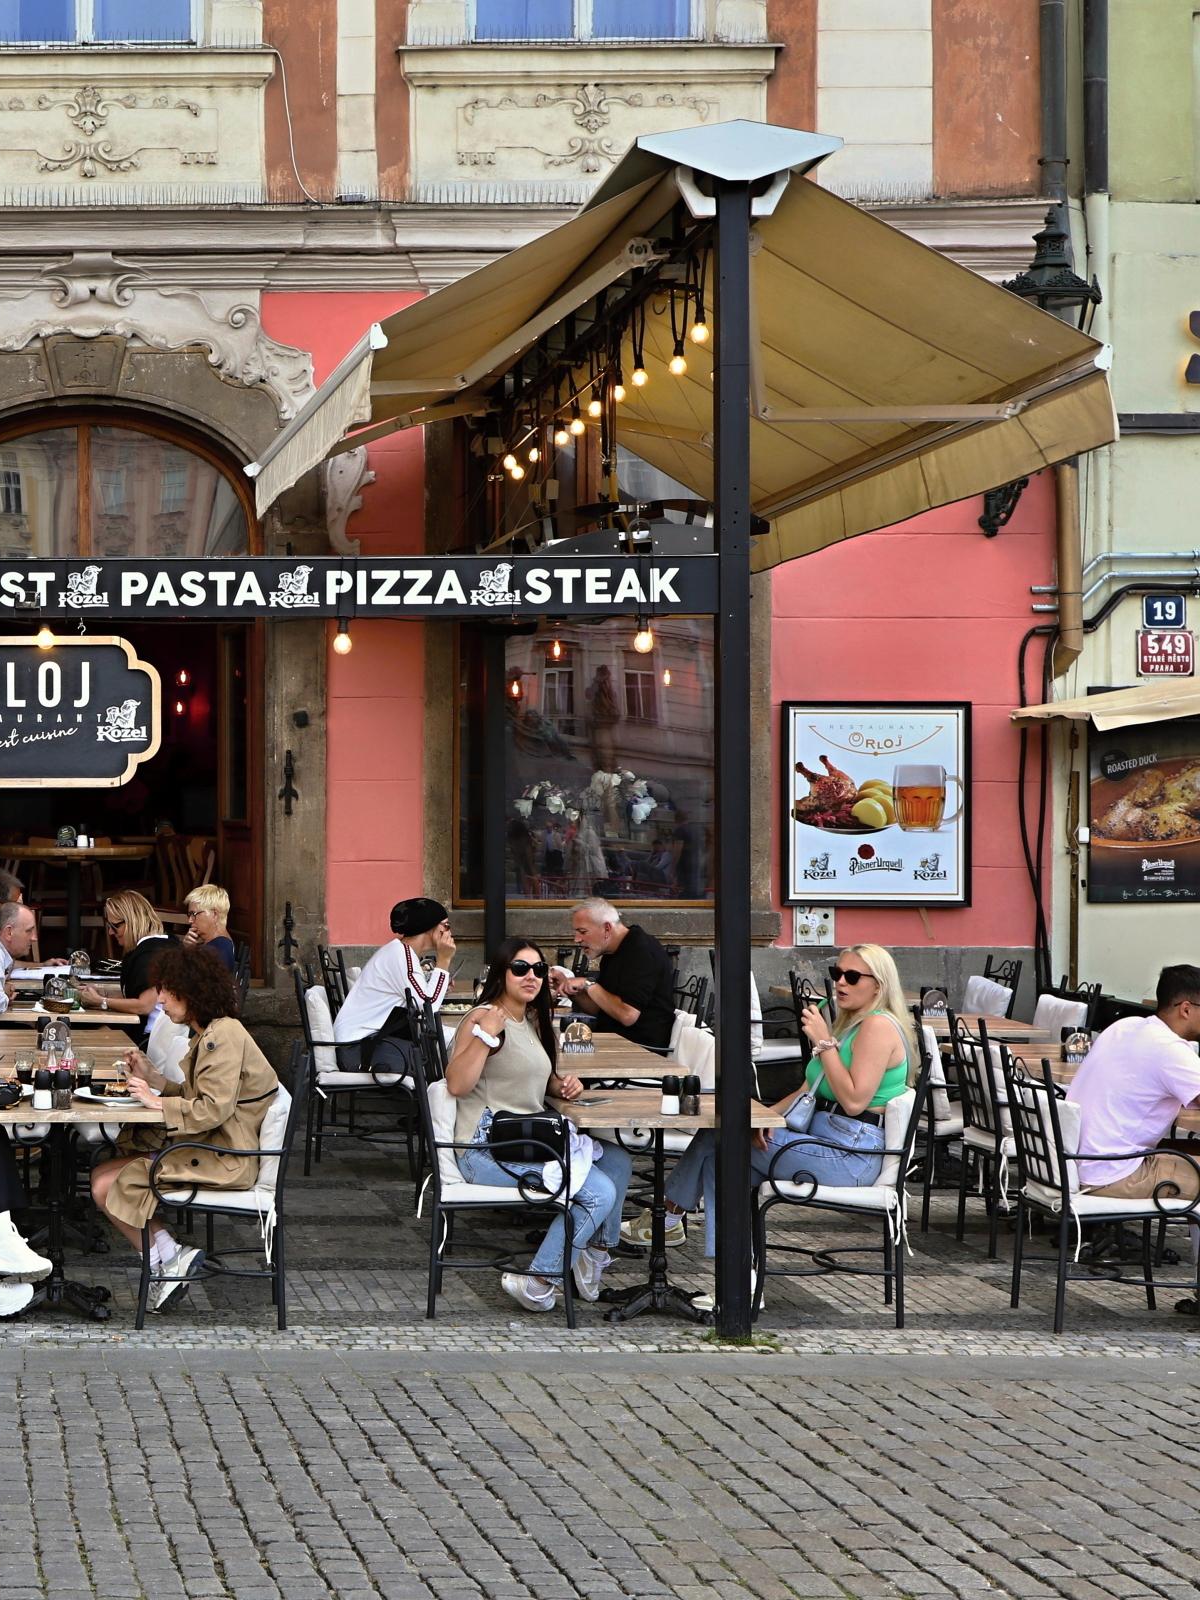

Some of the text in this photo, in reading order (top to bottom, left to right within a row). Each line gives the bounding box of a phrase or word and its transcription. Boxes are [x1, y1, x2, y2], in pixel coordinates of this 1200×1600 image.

[58, 591, 109, 609] Kozel
[121, 570, 266, 607] PASTA
[269, 590, 320, 609] Kozel
[326, 569, 468, 605] PIZZA
[470, 589, 522, 608] Kozel
[525, 567, 681, 605] STEAK
[1153, 601, 1176, 620] 19
[1147, 635, 1185, 654] 549
[1143, 653, 1190, 663] STARÉ MĚSTO
[1149, 664, 1184, 672] PRAHA 1
[23, 727, 78, 745] cuisine
[96, 725, 148, 743] Kozel
[1107, 753, 1158, 774] ROASTED DUCK
[849, 857, 903, 875] Pilsner Urquell
[803, 870, 836, 881] Kozel
[914, 870, 947, 881] Kozel
